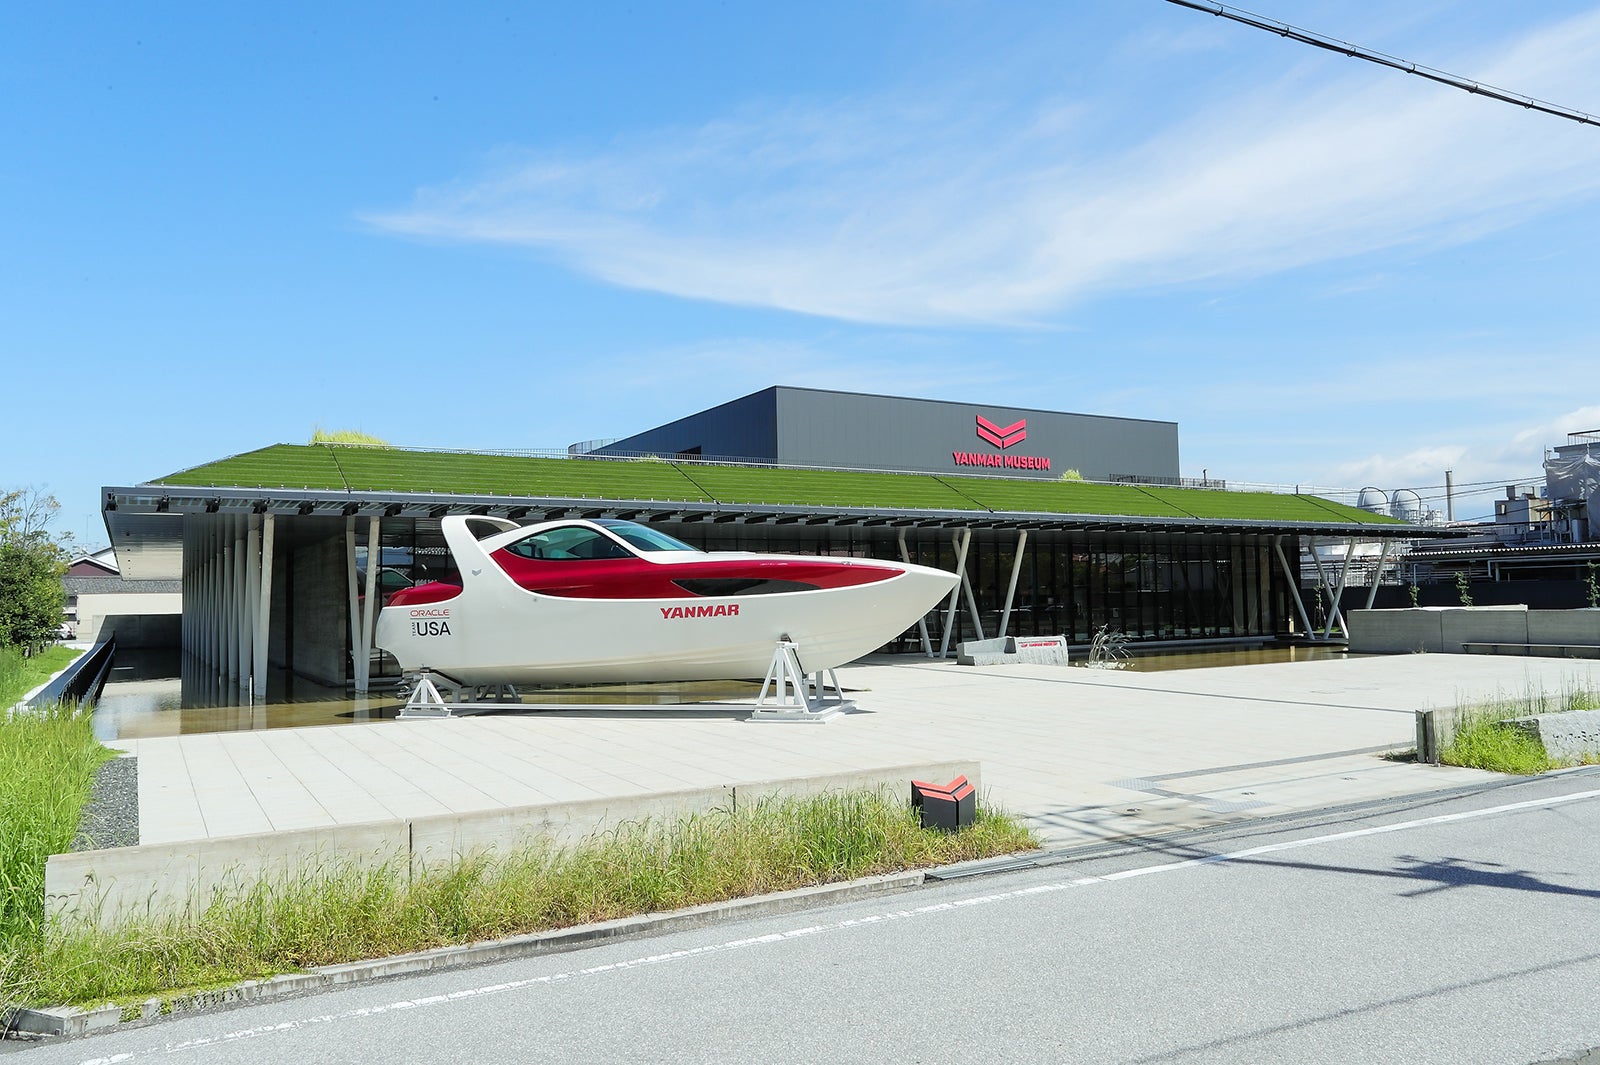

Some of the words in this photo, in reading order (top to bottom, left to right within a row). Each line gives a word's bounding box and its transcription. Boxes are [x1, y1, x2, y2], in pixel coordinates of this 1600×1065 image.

[953, 451, 1002, 468] YANMAR
[1003, 455, 1051, 471] MUSEUM
[410, 608, 450, 617] ORACLE
[660, 604, 739, 619] YANMAR
[416, 621, 451, 637] USA
